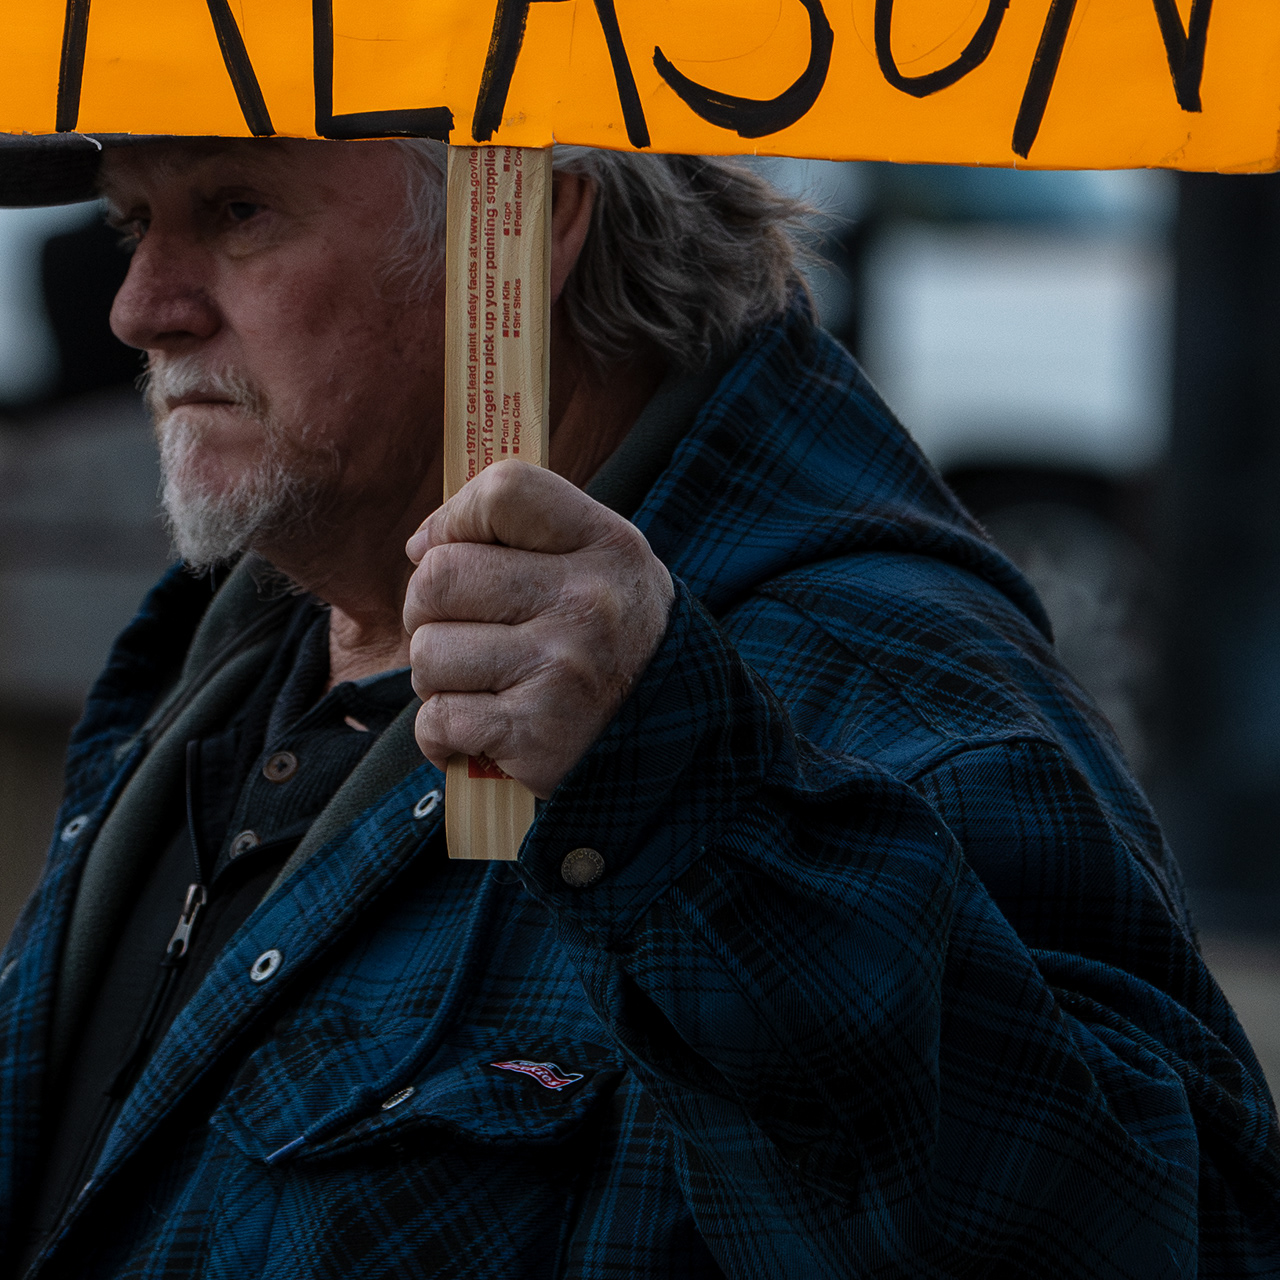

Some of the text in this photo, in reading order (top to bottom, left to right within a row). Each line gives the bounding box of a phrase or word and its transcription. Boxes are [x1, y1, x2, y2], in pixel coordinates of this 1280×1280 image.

[513, 169, 522, 199] Roller
[503, 202, 512, 227] Tape
[513, 201, 522, 227] Paint
[468, 247, 478, 258] at
[484, 208, 498, 270] painting
[467, 261, 478, 290] facts
[485, 273, 498, 308] your
[467, 293, 478, 329] safety
[502, 280, 510, 329] Paint Kits
[513, 278, 521, 329] Stir Sticks
[485, 311, 497, 331] up
[467, 332, 479, 362] paint
[483, 334, 497, 367] pick
[467, 365, 477, 390] lead
[483, 370, 495, 385] to
[467, 393, 477, 414] Get
[482, 388, 496, 434] forget
[501, 393, 511, 445] Paint Tray
[512, 392, 521, 445] Drop Cloth
[466, 420, 476, 455] 1978?
